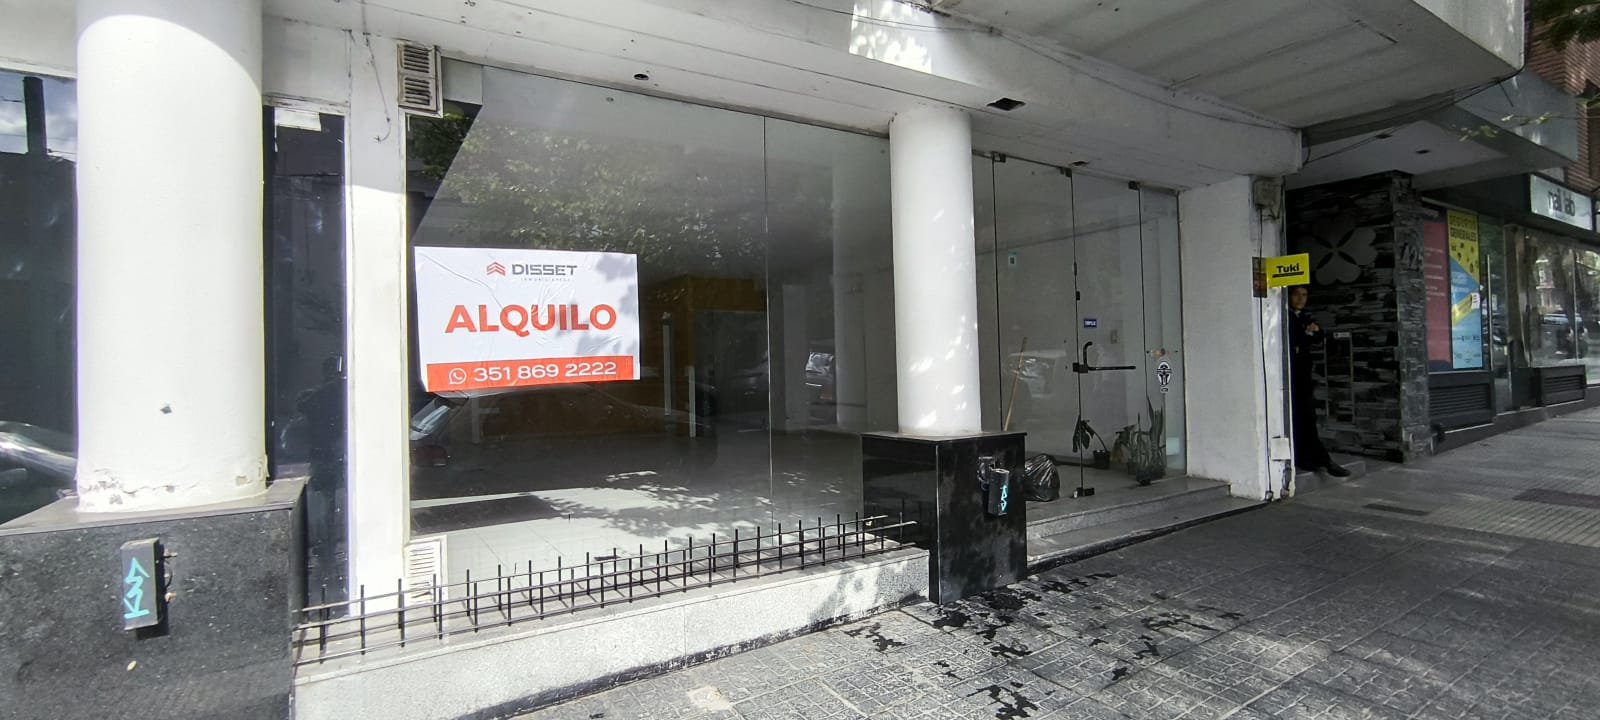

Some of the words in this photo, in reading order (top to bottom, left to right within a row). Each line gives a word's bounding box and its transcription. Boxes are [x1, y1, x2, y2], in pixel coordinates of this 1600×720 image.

[511, 263, 578, 276] DISSET
[1276, 263, 1300, 273] Tuki
[444, 303, 618, 338] ALQUILO
[473, 366, 511, 382] 351
[517, 364, 560, 380] 869
[564, 361, 618, 377] 2222
